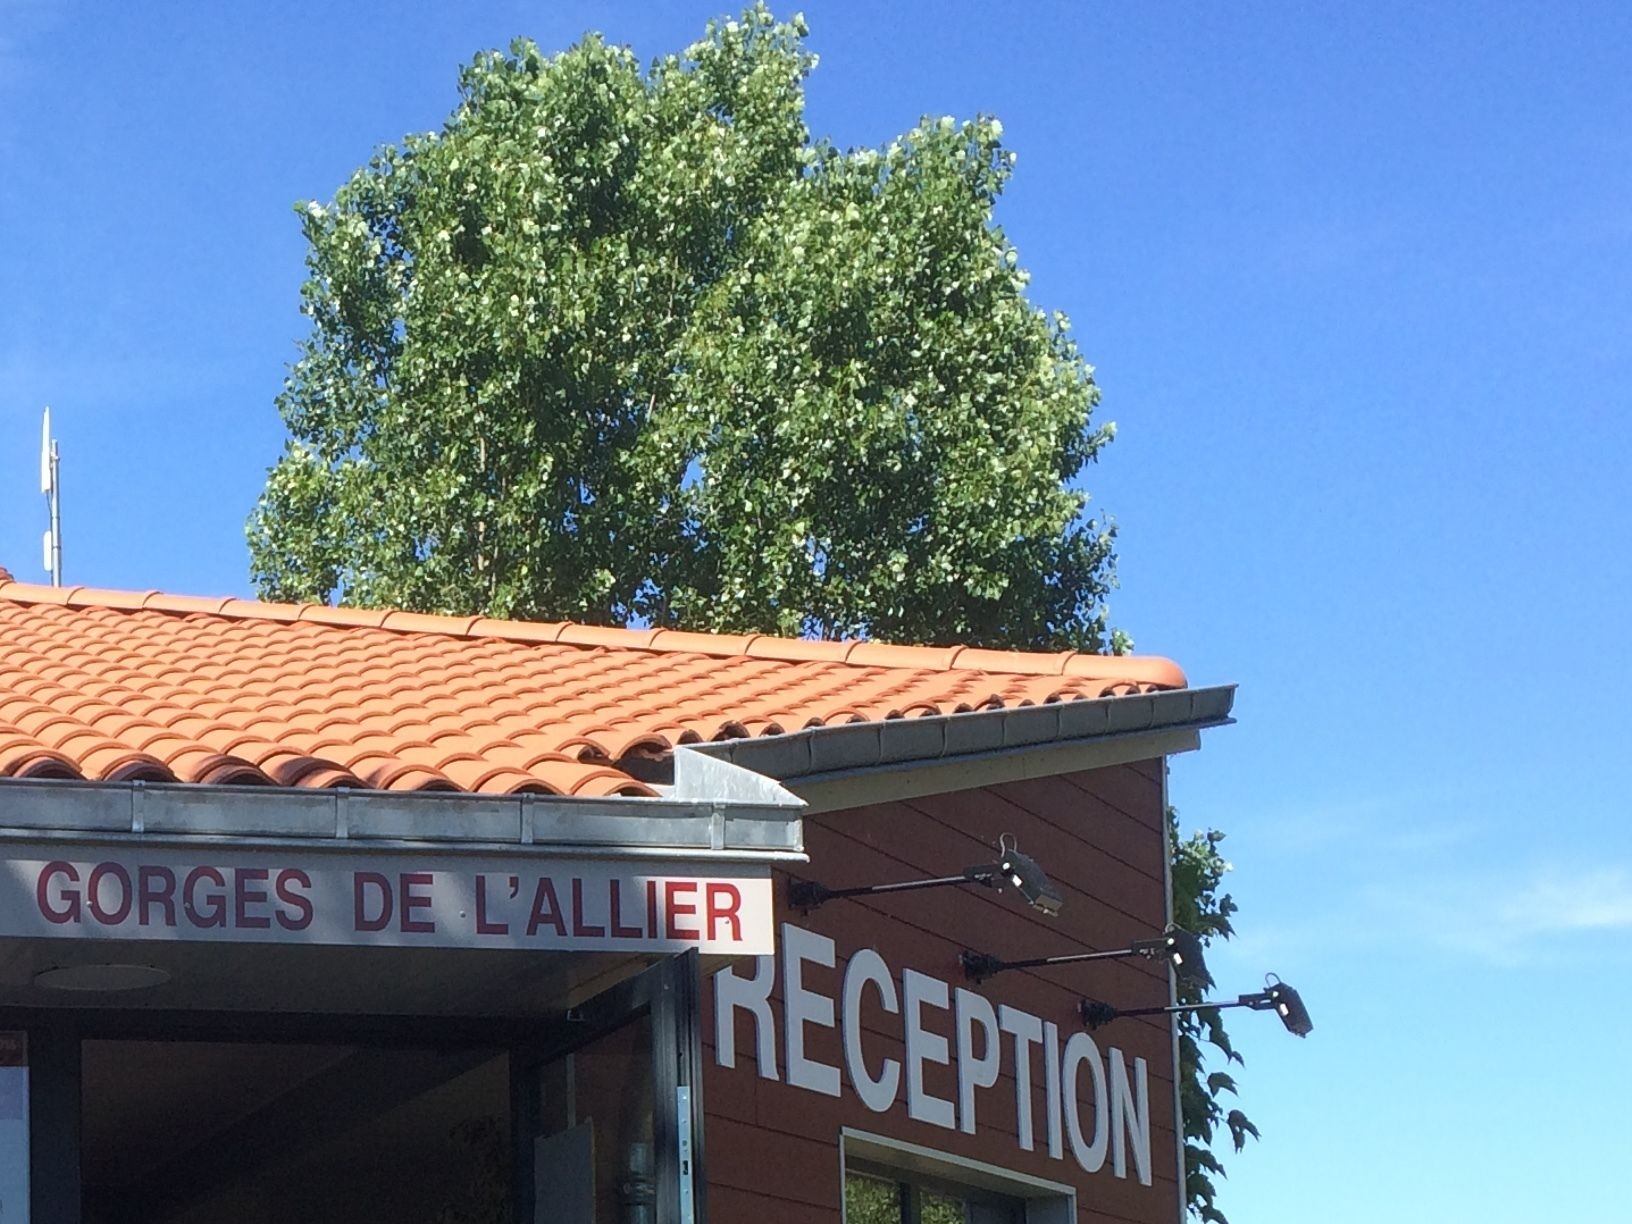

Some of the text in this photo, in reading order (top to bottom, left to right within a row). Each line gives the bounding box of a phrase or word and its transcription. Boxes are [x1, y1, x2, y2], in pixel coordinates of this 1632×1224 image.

[35, 862, 314, 932] GORGES
[354, 872, 435, 934] DE
[474, 873, 744, 943] L'ALLIER
[714, 922, 1153, 1187] RECEPTION
